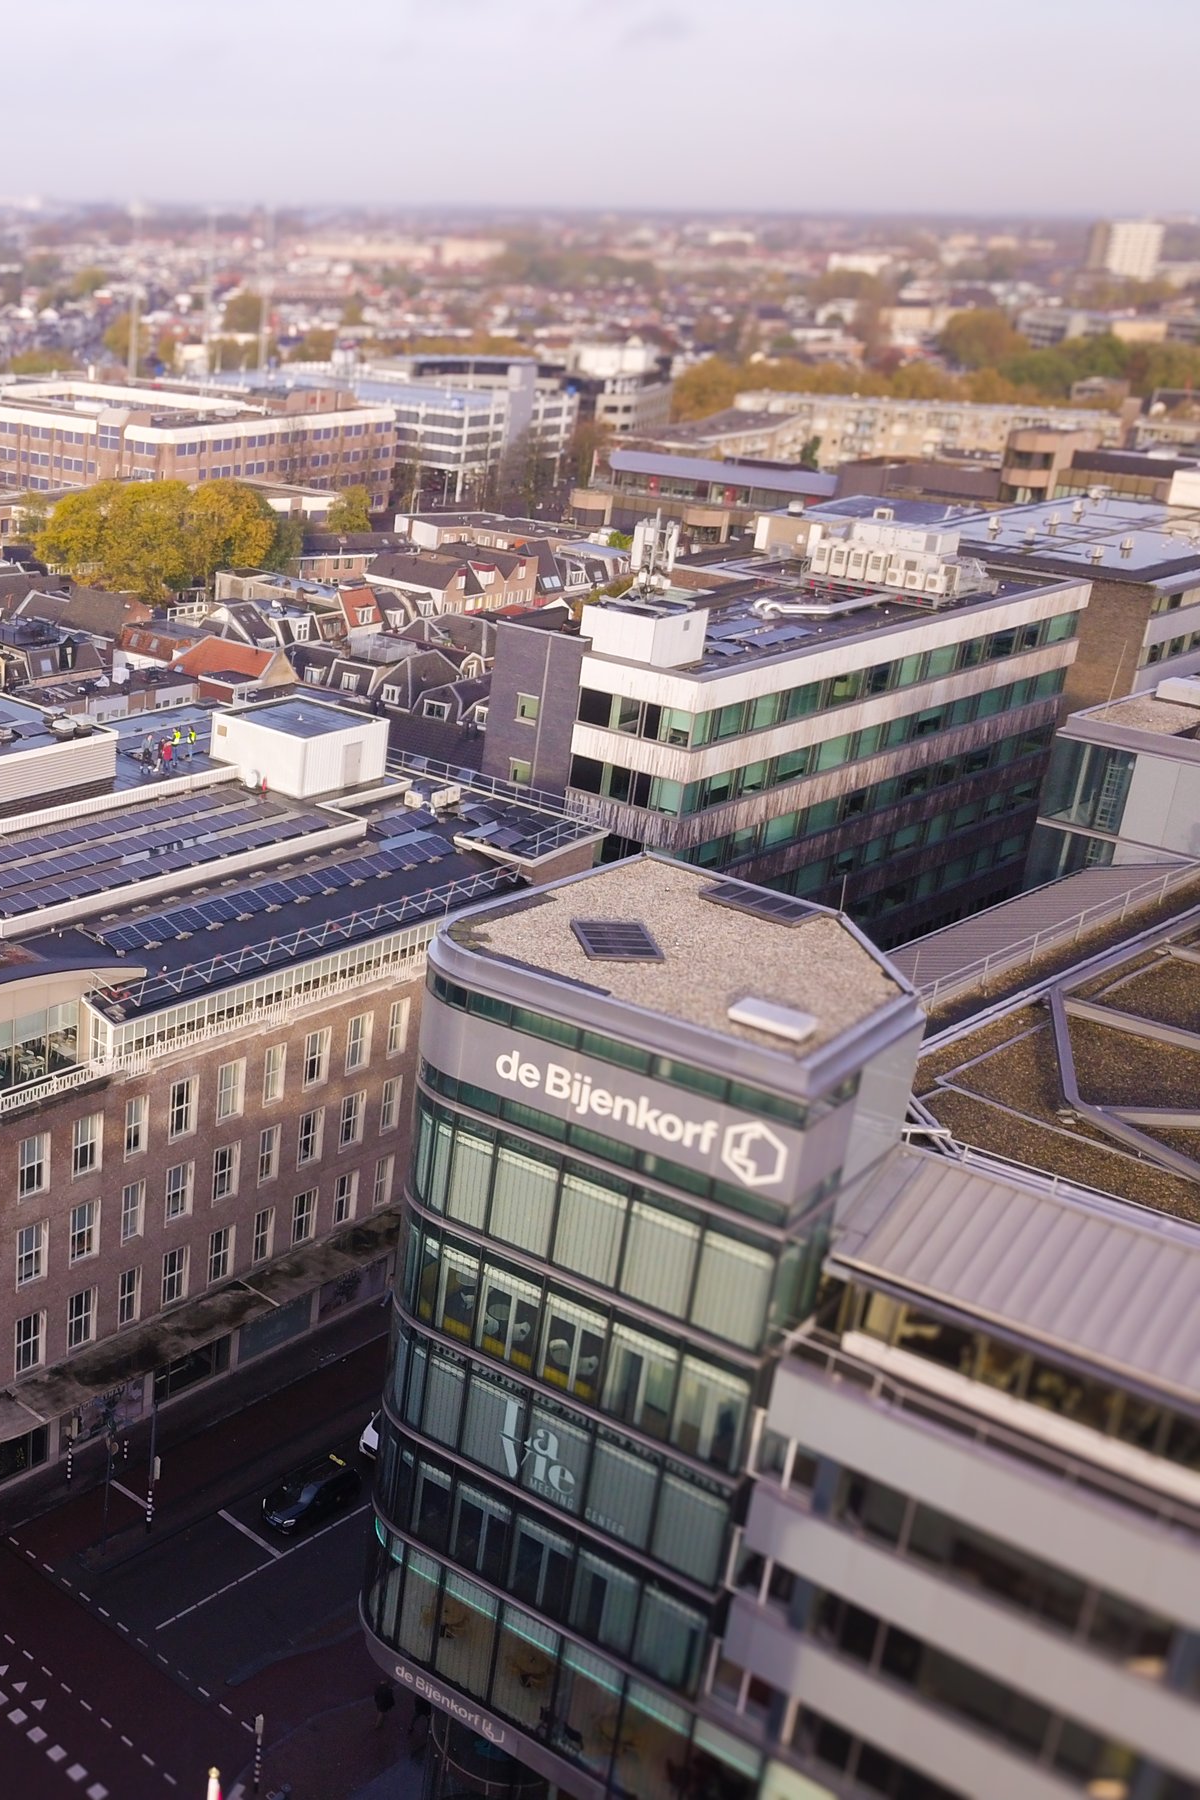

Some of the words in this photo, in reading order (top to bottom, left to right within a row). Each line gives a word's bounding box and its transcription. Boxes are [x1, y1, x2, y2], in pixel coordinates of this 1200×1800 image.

[495, 1050, 541, 1089] de
[544, 1062, 718, 1155] Bijenkorf
[499, 1399, 560, 1461] La
[499, 1433, 576, 1495] Vie
[529, 1476, 575, 1511] MEETING
[584, 1506, 625, 1537] CENTER
[395, 1665, 414, 1683] de
[415, 1676, 481, 1728] Bijenkorf
